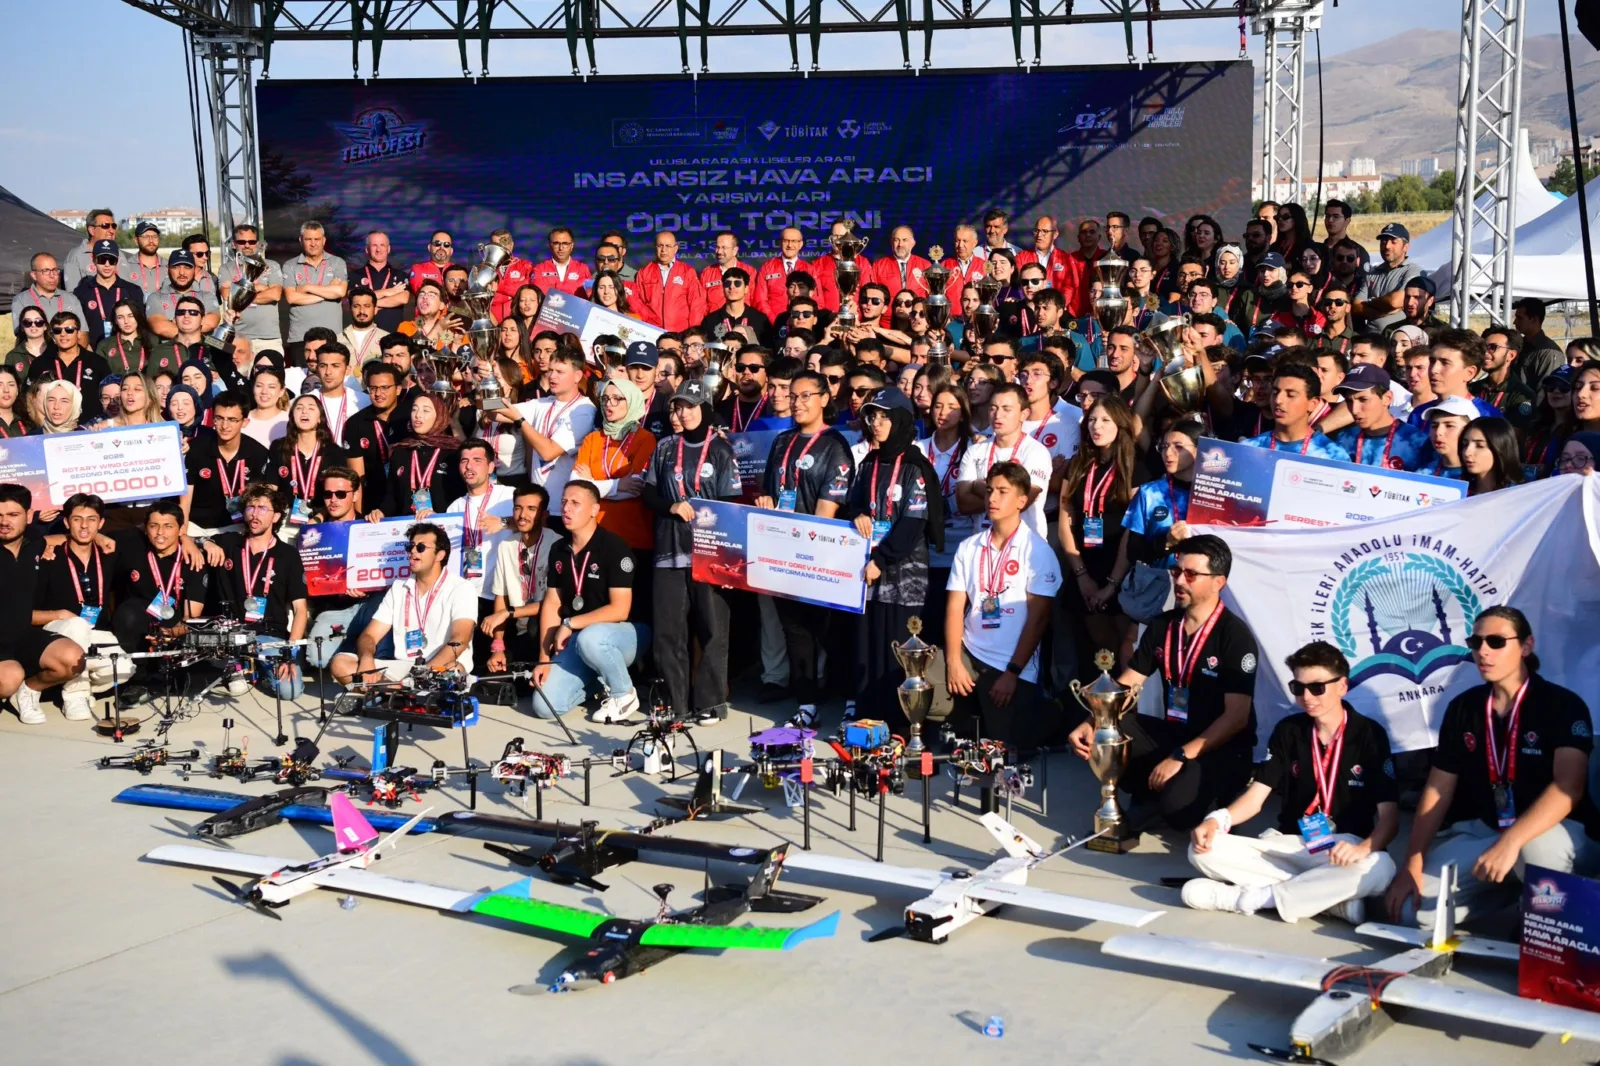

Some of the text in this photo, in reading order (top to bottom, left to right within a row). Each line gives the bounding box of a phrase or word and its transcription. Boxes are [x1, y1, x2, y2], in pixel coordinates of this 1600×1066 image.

[785, 125, 828, 138] TÜBİTAK
[342, 132, 426, 163] TEKNOFEST
[649, 157, 752, 166] ULUSLARARASI
[814, 155, 856, 163] ARASI
[734, 167, 821, 185] HAVA
[828, 166, 932, 184] ARACI
[62, 465, 98, 474] ROTARY
[70, 471, 102, 480] SECOND
[131, 464, 162, 472] AWARD
[62, 475, 158, 498] 200.000
[1194, 485, 1216, 494] HAVA
[1384, 490, 1410, 502] TÜBİTAK
[1284, 514, 1332, 526] SERBEST
[1333, 534, 1402, 572] ANADOLU
[1384, 551, 1405, 562] 1951
[758, 556, 786, 566] SERBEST
[356, 566, 410, 582] 200.0
[769, 565, 816, 580] PERFORMANS
[1399, 684, 1445, 702] ANKARA
[1523, 927, 1552, 940] HAVA
[1556, 920, 1584, 934] ARASI
